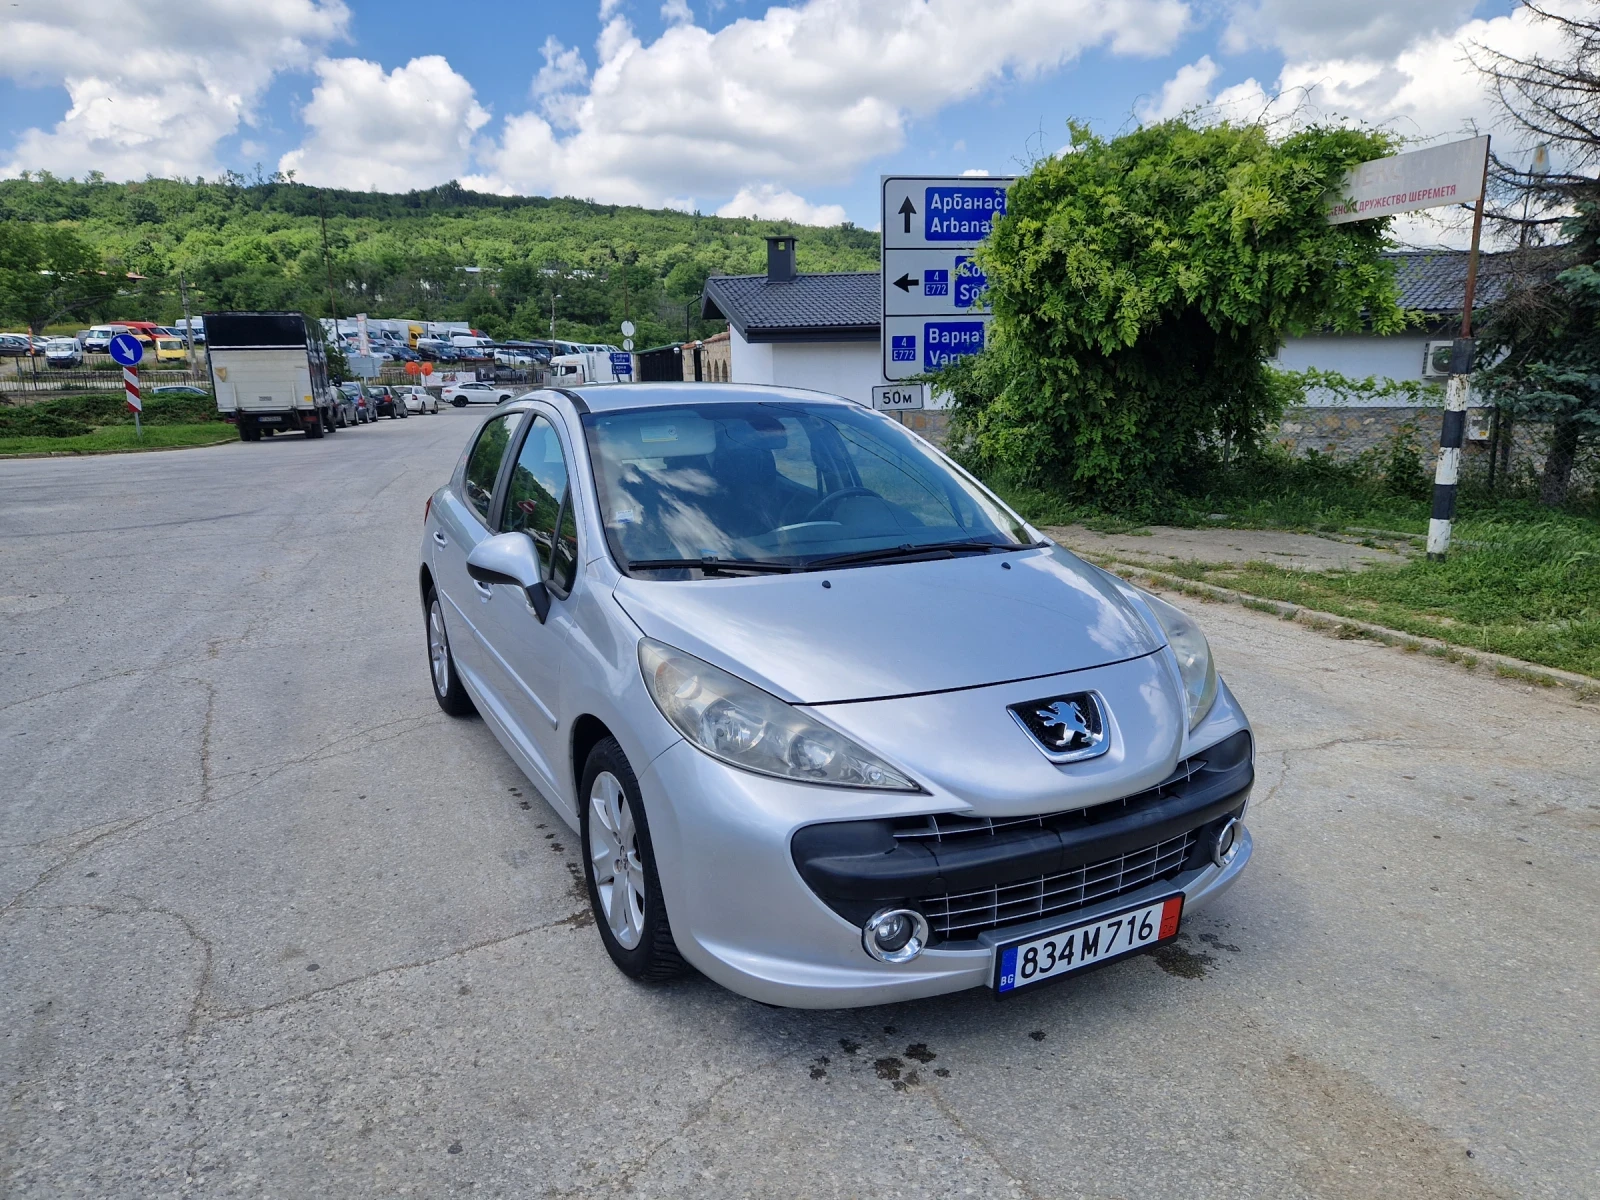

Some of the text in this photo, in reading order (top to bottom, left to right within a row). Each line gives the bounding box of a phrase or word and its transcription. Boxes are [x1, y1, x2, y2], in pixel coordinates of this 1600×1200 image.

[1358, 193, 1407, 212] ДРУЖЕСТВО
[1408, 184, 1457, 203] ШЕРЕМЕТЯ
[930, 216, 994, 233] Arbana
[958, 261, 987, 277] Со
[933, 272, 940, 281] 4
[925, 284, 948, 295] E772
[901, 337, 907, 347] 4
[929, 328, 980, 347] Варна
[893, 350, 915, 360] E772
[1000, 973, 1014, 987] BG
